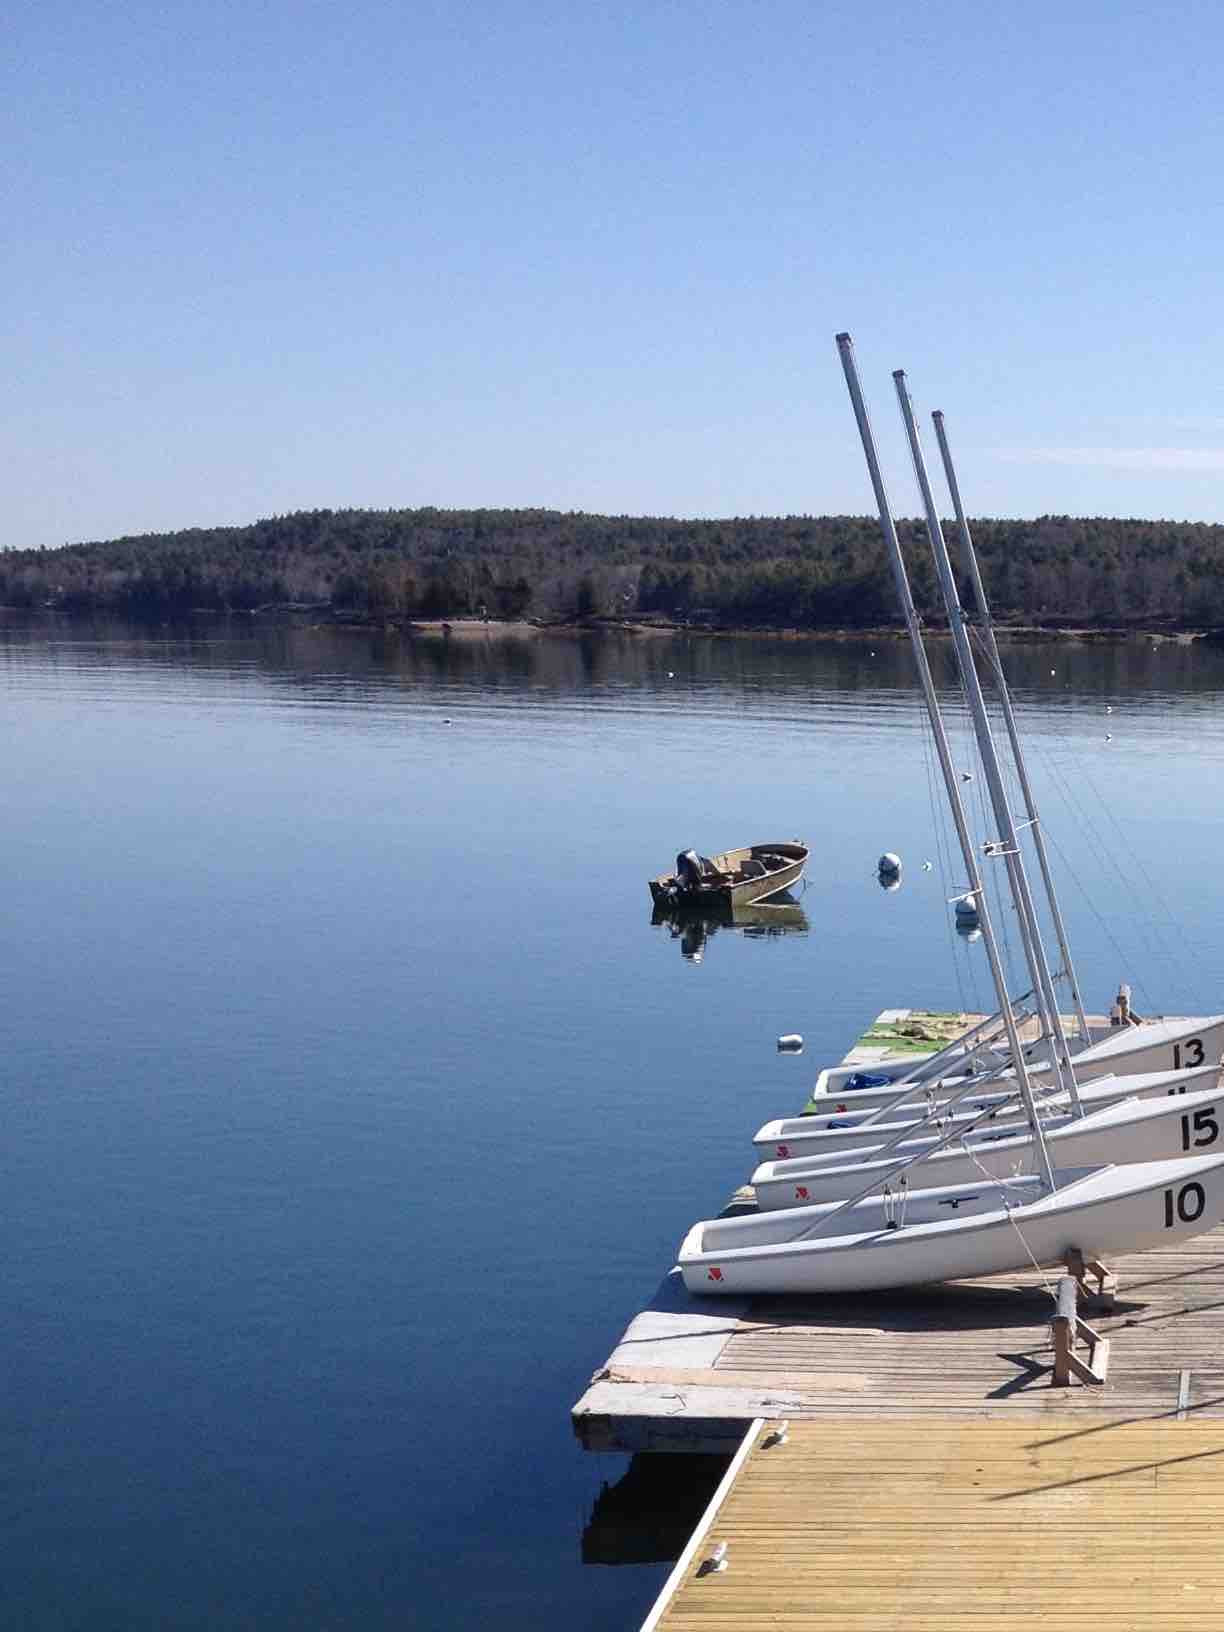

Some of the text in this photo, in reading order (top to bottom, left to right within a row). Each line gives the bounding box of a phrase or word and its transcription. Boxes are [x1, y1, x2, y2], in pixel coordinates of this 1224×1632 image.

[1173, 1039, 1205, 1069] 13
[1181, 1107, 1219, 1151] 15
[1164, 1182, 1206, 1228] 10
